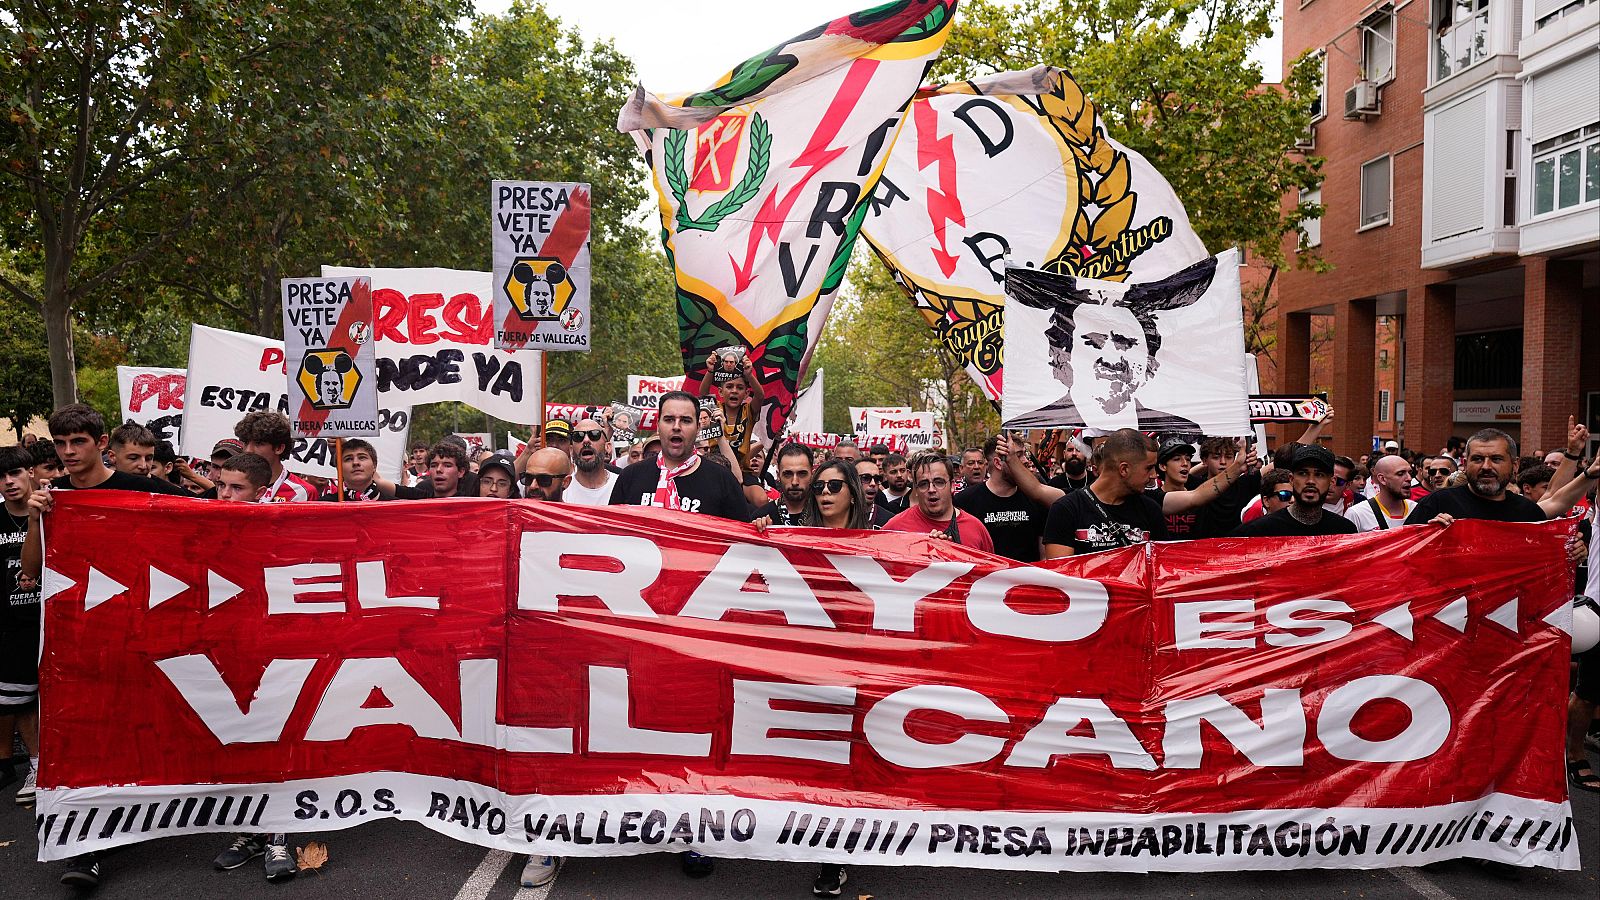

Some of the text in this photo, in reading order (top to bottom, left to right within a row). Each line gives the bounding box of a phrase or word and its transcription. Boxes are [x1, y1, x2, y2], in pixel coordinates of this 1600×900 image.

[499, 186, 571, 211] PRESA
[498, 212, 551, 233] VETE
[509, 233, 538, 253] YA
[778, 242, 821, 298] V
[288, 281, 353, 305] PRESA
[288, 307, 336, 327] VETE
[299, 328, 326, 346] YA
[498, 331, 587, 345] FUERA DE VALLECAS
[472, 352, 523, 402] YA
[201, 386, 271, 412] ESTA
[632, 396, 657, 408] NOS
[1498, 399, 1521, 413] Asse
[293, 420, 321, 431] FUERA
[323, 421, 333, 430] DE
[334, 420, 376, 431] VALLECAS
[264, 531, 1355, 649] EL RAYO ES
[153, 654, 1452, 770] VALLECANO
[294, 788, 1370, 858] S.O.S. RAYO VALLECANO PRESA INHABILITACIÓN
